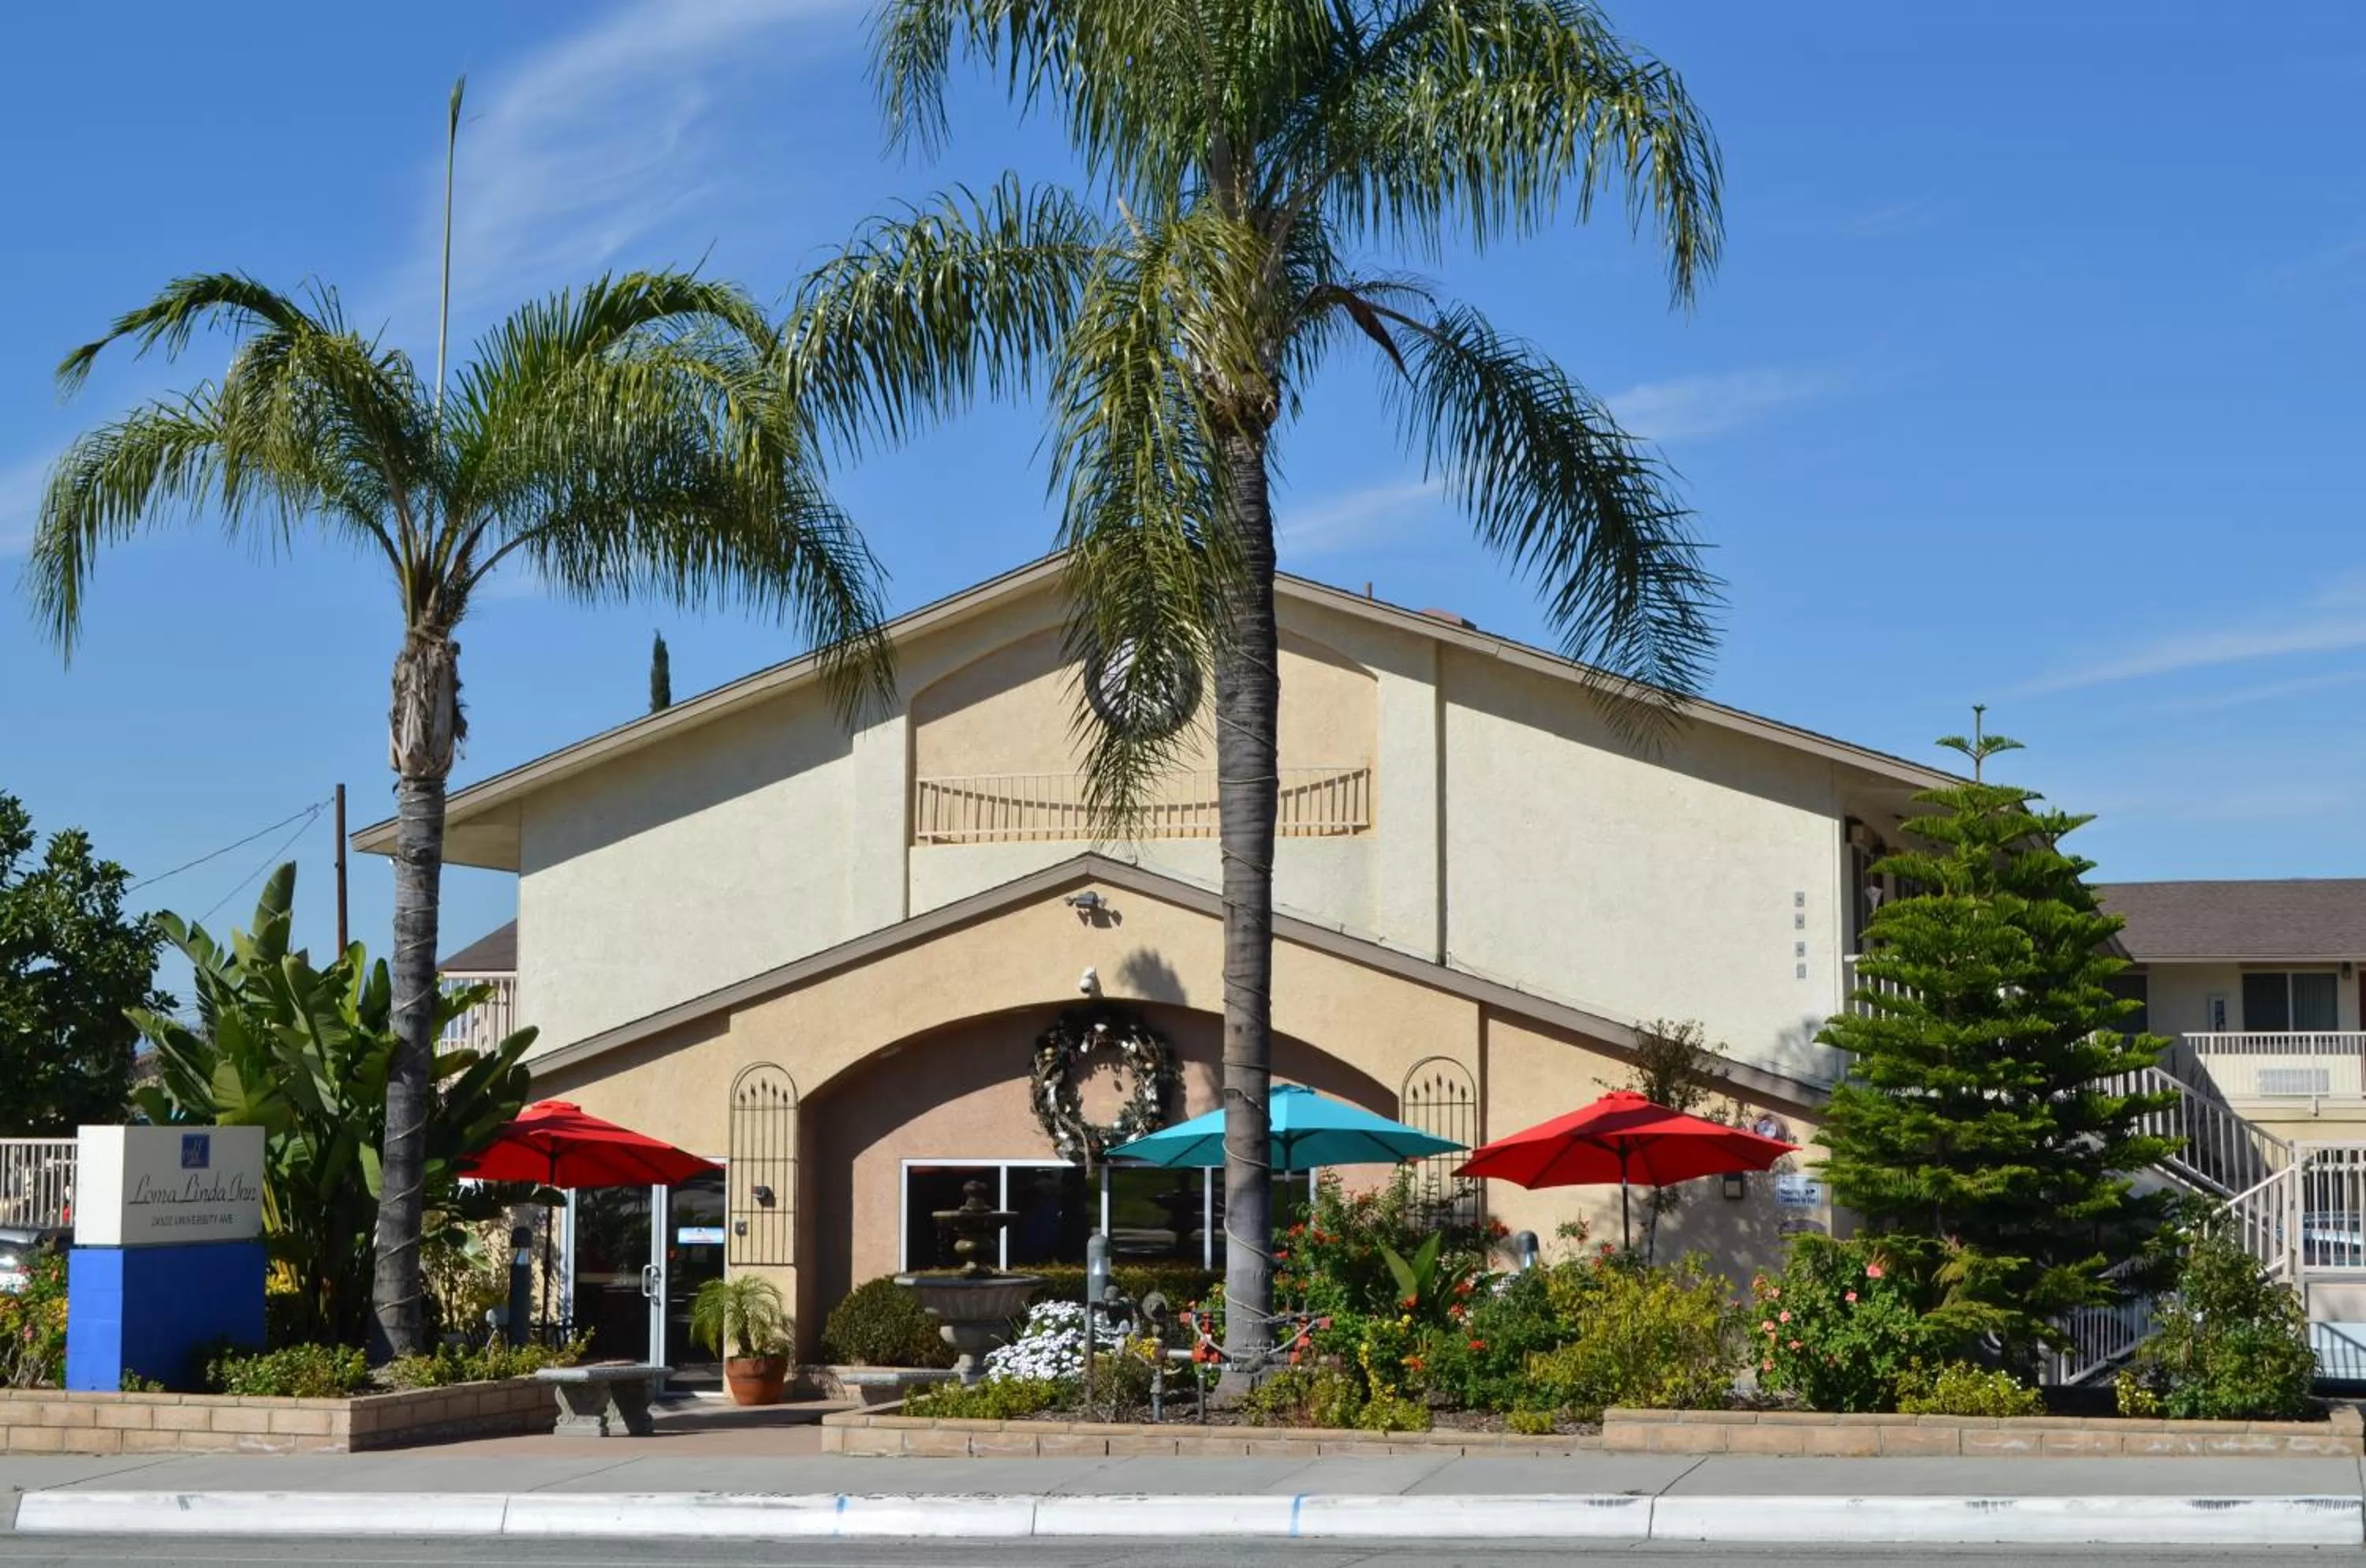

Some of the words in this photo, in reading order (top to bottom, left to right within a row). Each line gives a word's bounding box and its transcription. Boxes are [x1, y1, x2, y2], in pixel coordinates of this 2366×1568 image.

[128, 1174, 176, 1204] Loma
[177, 1172, 226, 1203] Linda
[227, 1174, 256, 1202] Inn
[174, 1215, 218, 1225] UNIVERSITY
